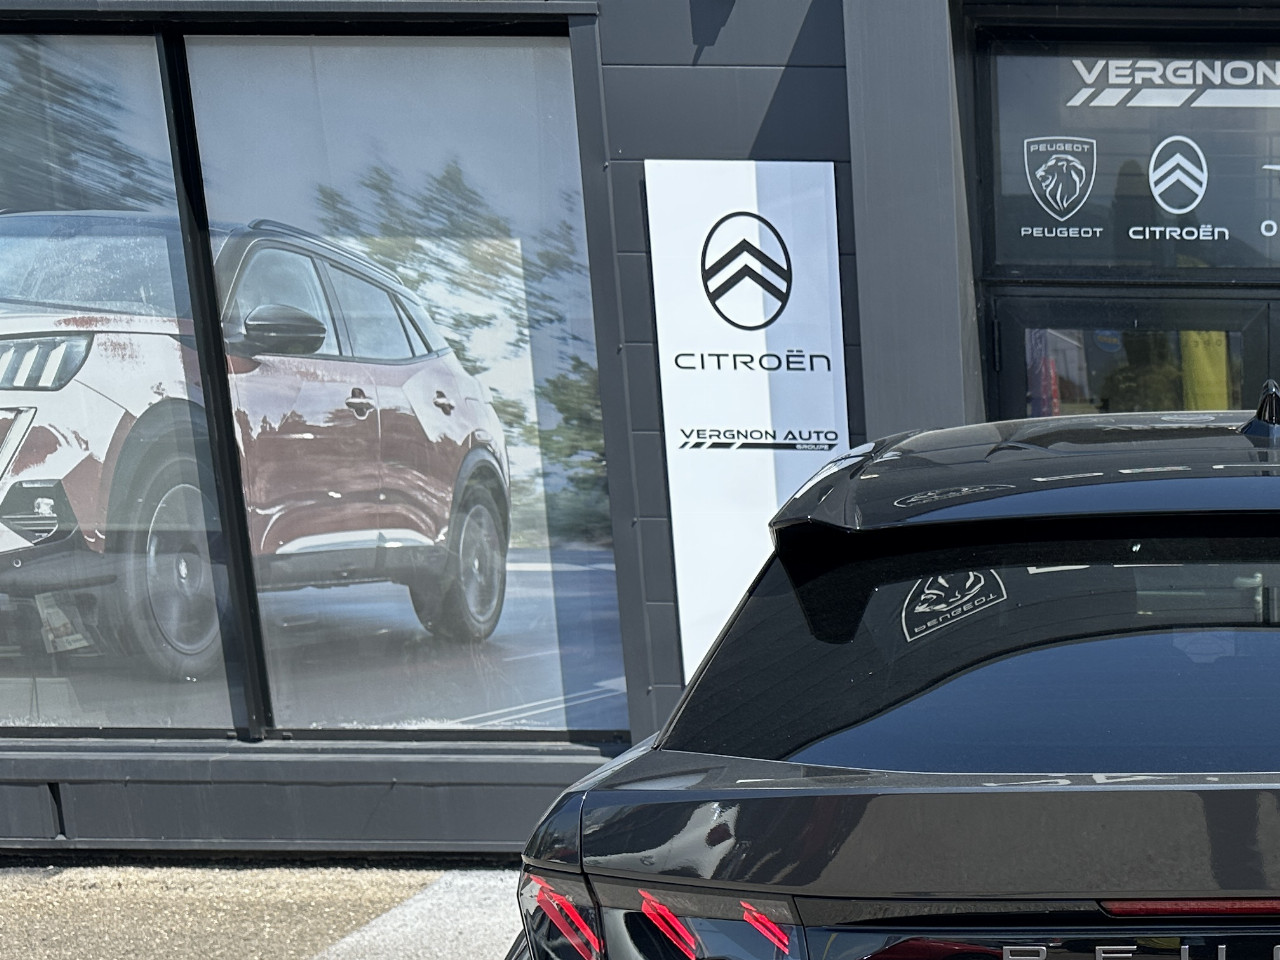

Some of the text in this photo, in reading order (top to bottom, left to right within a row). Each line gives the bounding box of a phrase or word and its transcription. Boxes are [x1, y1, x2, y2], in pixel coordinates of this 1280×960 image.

[1030, 143, 1090, 153] PEUGEOT
[1021, 227, 1103, 237] PEUGEOT
[680, 429, 839, 441] VERGNON AUTO
